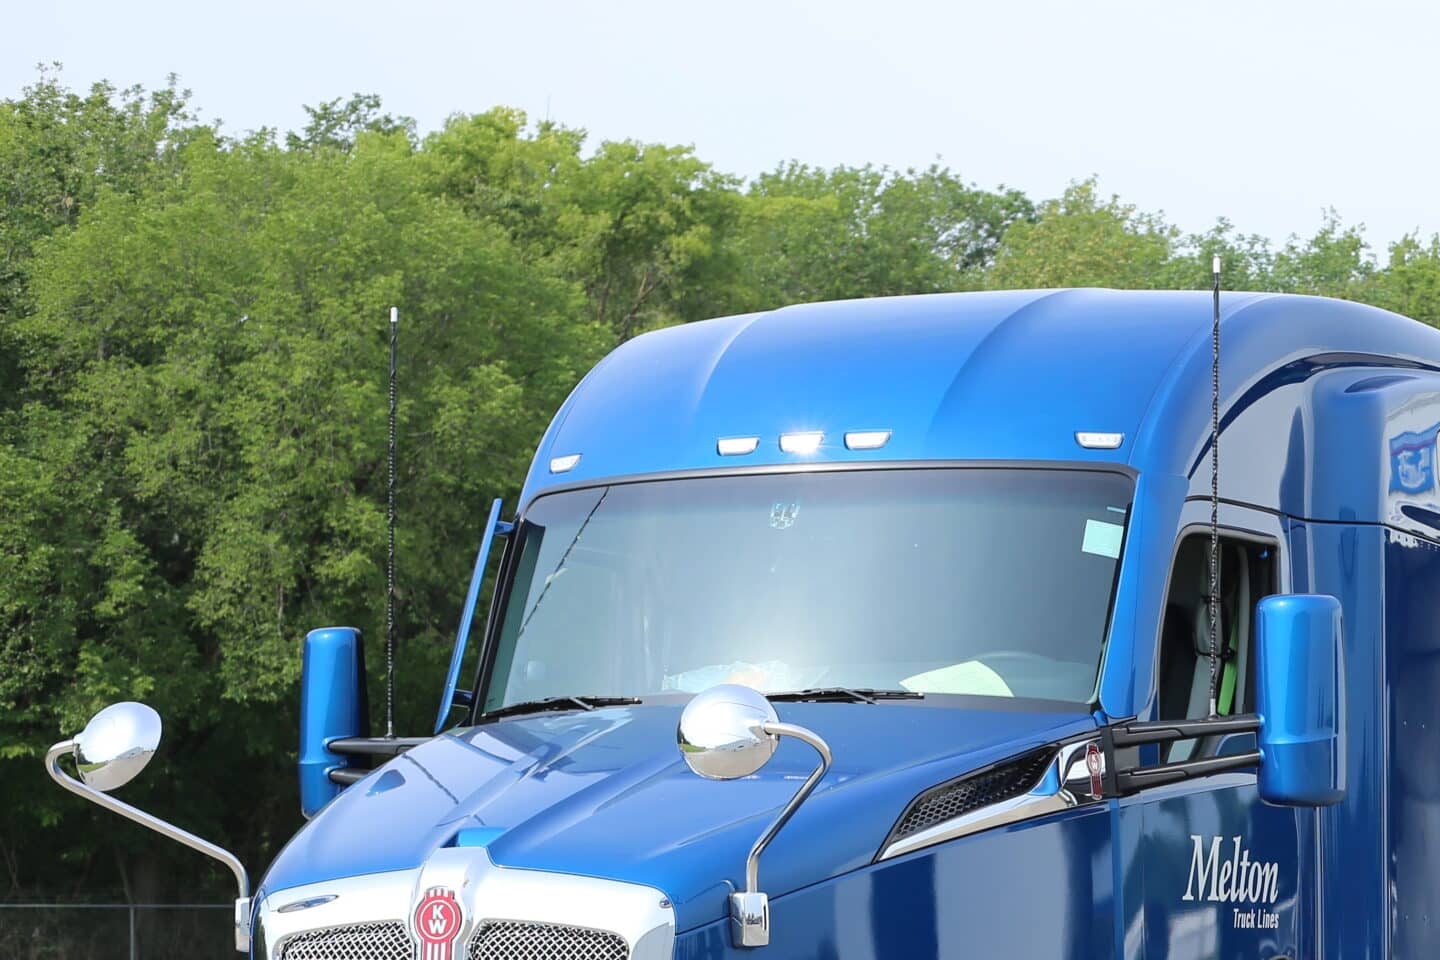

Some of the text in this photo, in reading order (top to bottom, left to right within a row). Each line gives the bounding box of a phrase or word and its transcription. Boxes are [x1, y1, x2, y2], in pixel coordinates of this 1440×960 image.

[1182, 834, 1279, 904] Melton
[1233, 908, 1280, 929] Truck Lines
